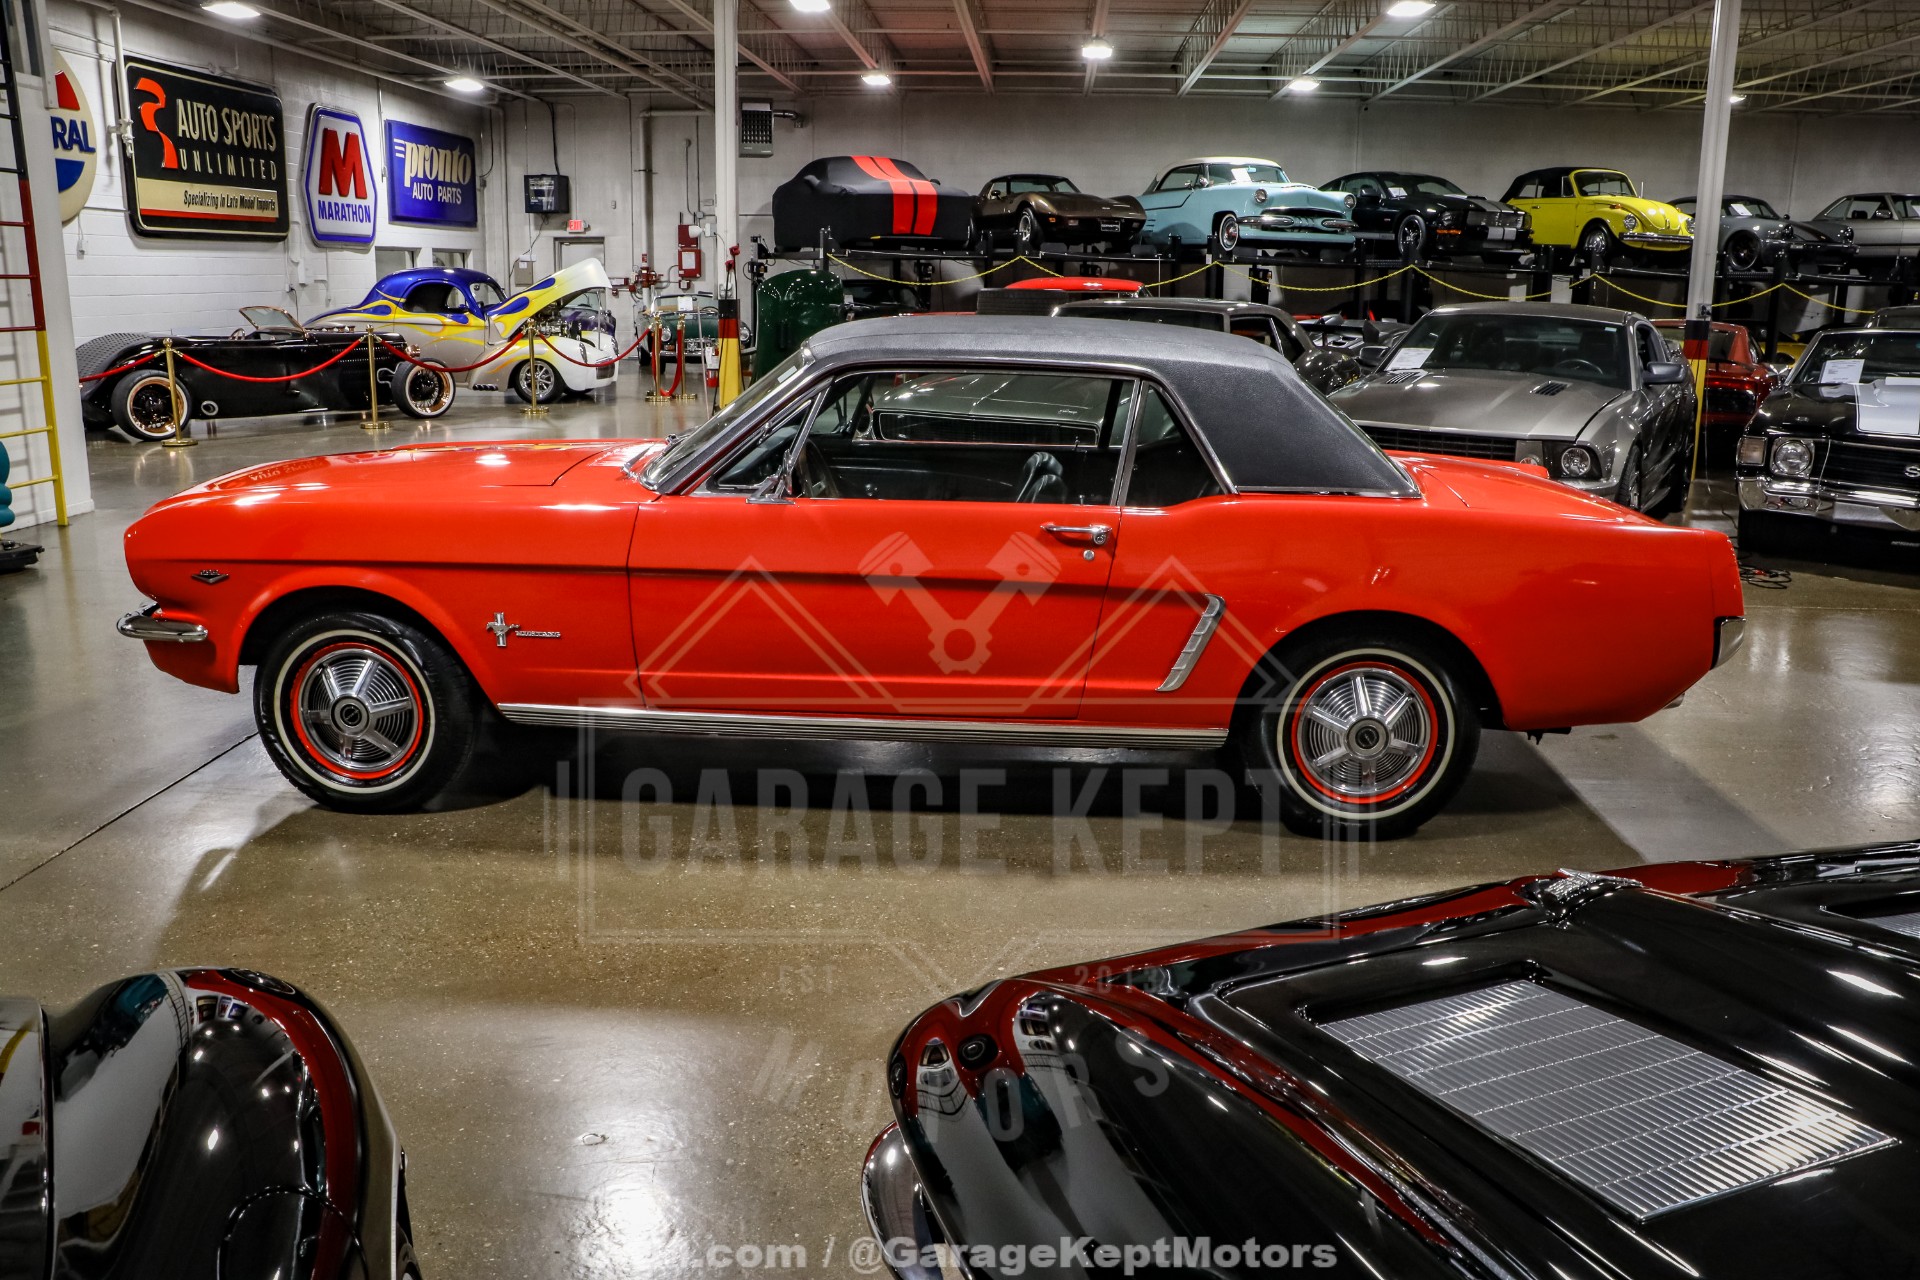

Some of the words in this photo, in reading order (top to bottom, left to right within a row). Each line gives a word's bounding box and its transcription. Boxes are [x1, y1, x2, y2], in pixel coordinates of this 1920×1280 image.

[177, 98, 218, 144] AUTO
[221, 107, 277, 151] SPORTS
[179, 148, 277, 181] UNLIMITED
[319, 128, 367, 199] M
[403, 141, 472, 187] pronto
[184, 190, 218, 209] Specializing
[240, 194, 255, 209] Model
[412, 182, 433, 201] AUTO
[437, 186, 462, 205] PARTS
[318, 200, 371, 223] MARATHON
[568, 219, 582, 231] EXIT
